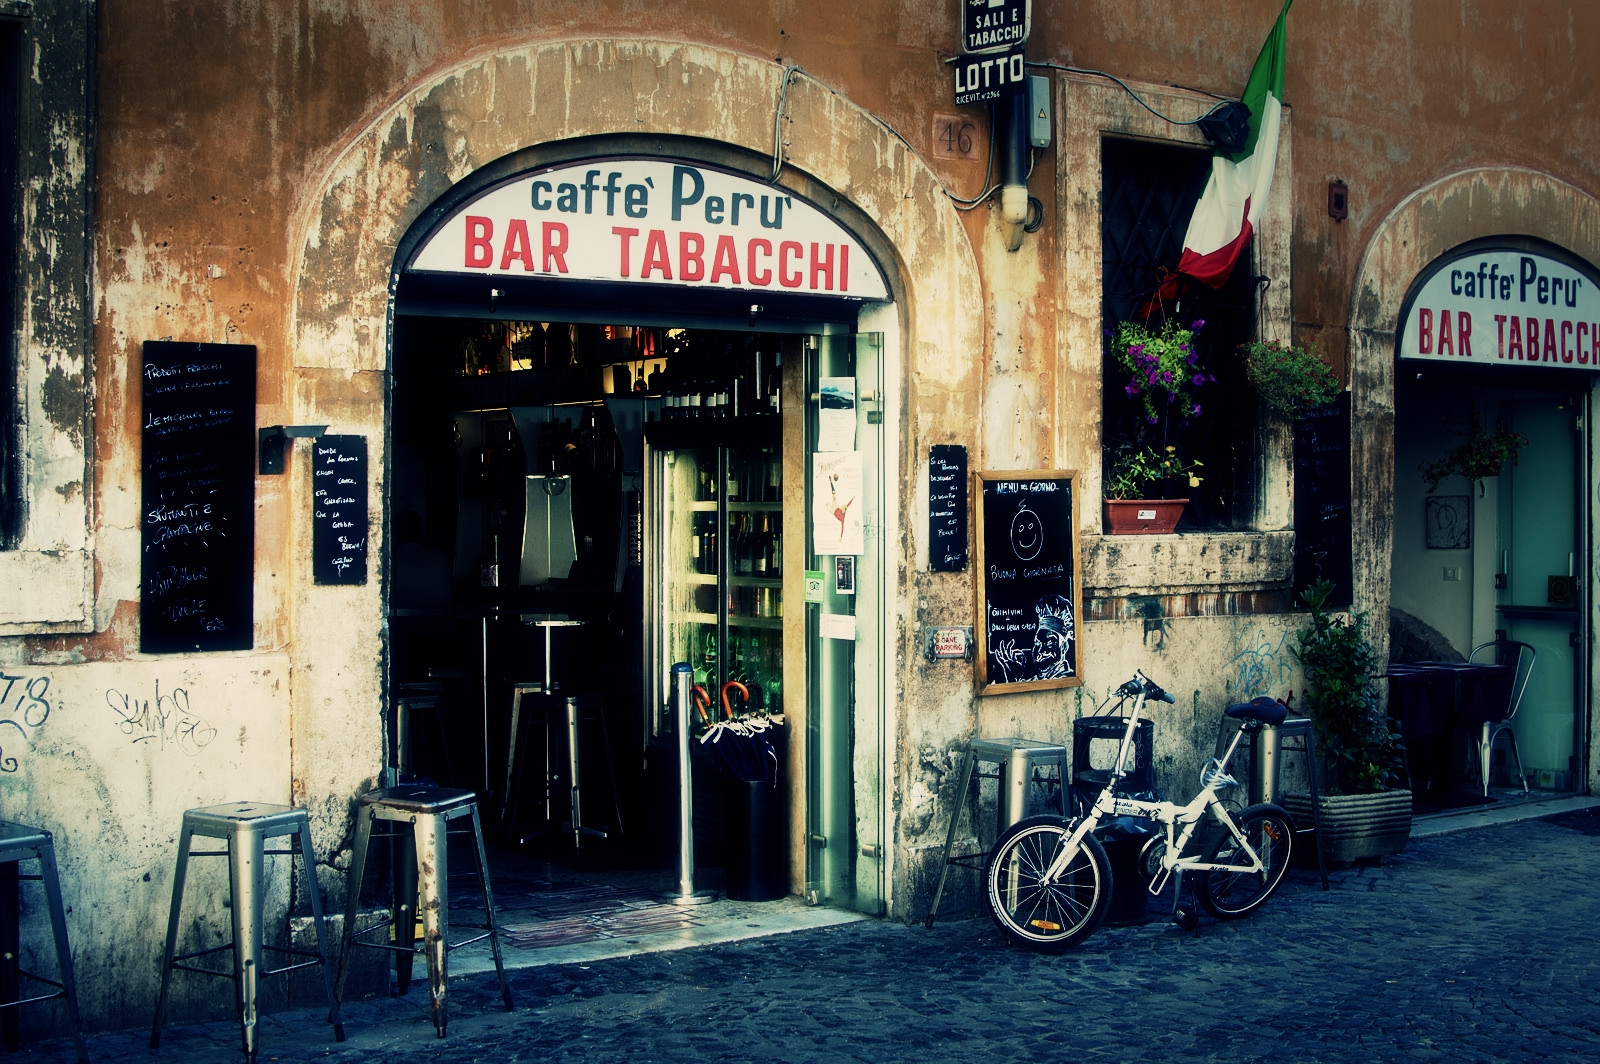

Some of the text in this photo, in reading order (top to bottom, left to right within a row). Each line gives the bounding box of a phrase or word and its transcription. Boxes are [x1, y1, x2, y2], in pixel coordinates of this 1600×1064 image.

[969, 24, 1023, 47] TABACCHI
[976, 8, 1018, 28] SALI E
[955, 53, 1024, 93] LOTTO
[939, 122, 976, 153] 46
[465, 215, 848, 292] BAR TABACCHI
[1419, 308, 1472, 356] BAR
[629, 513, 640, 567] AMPARI
